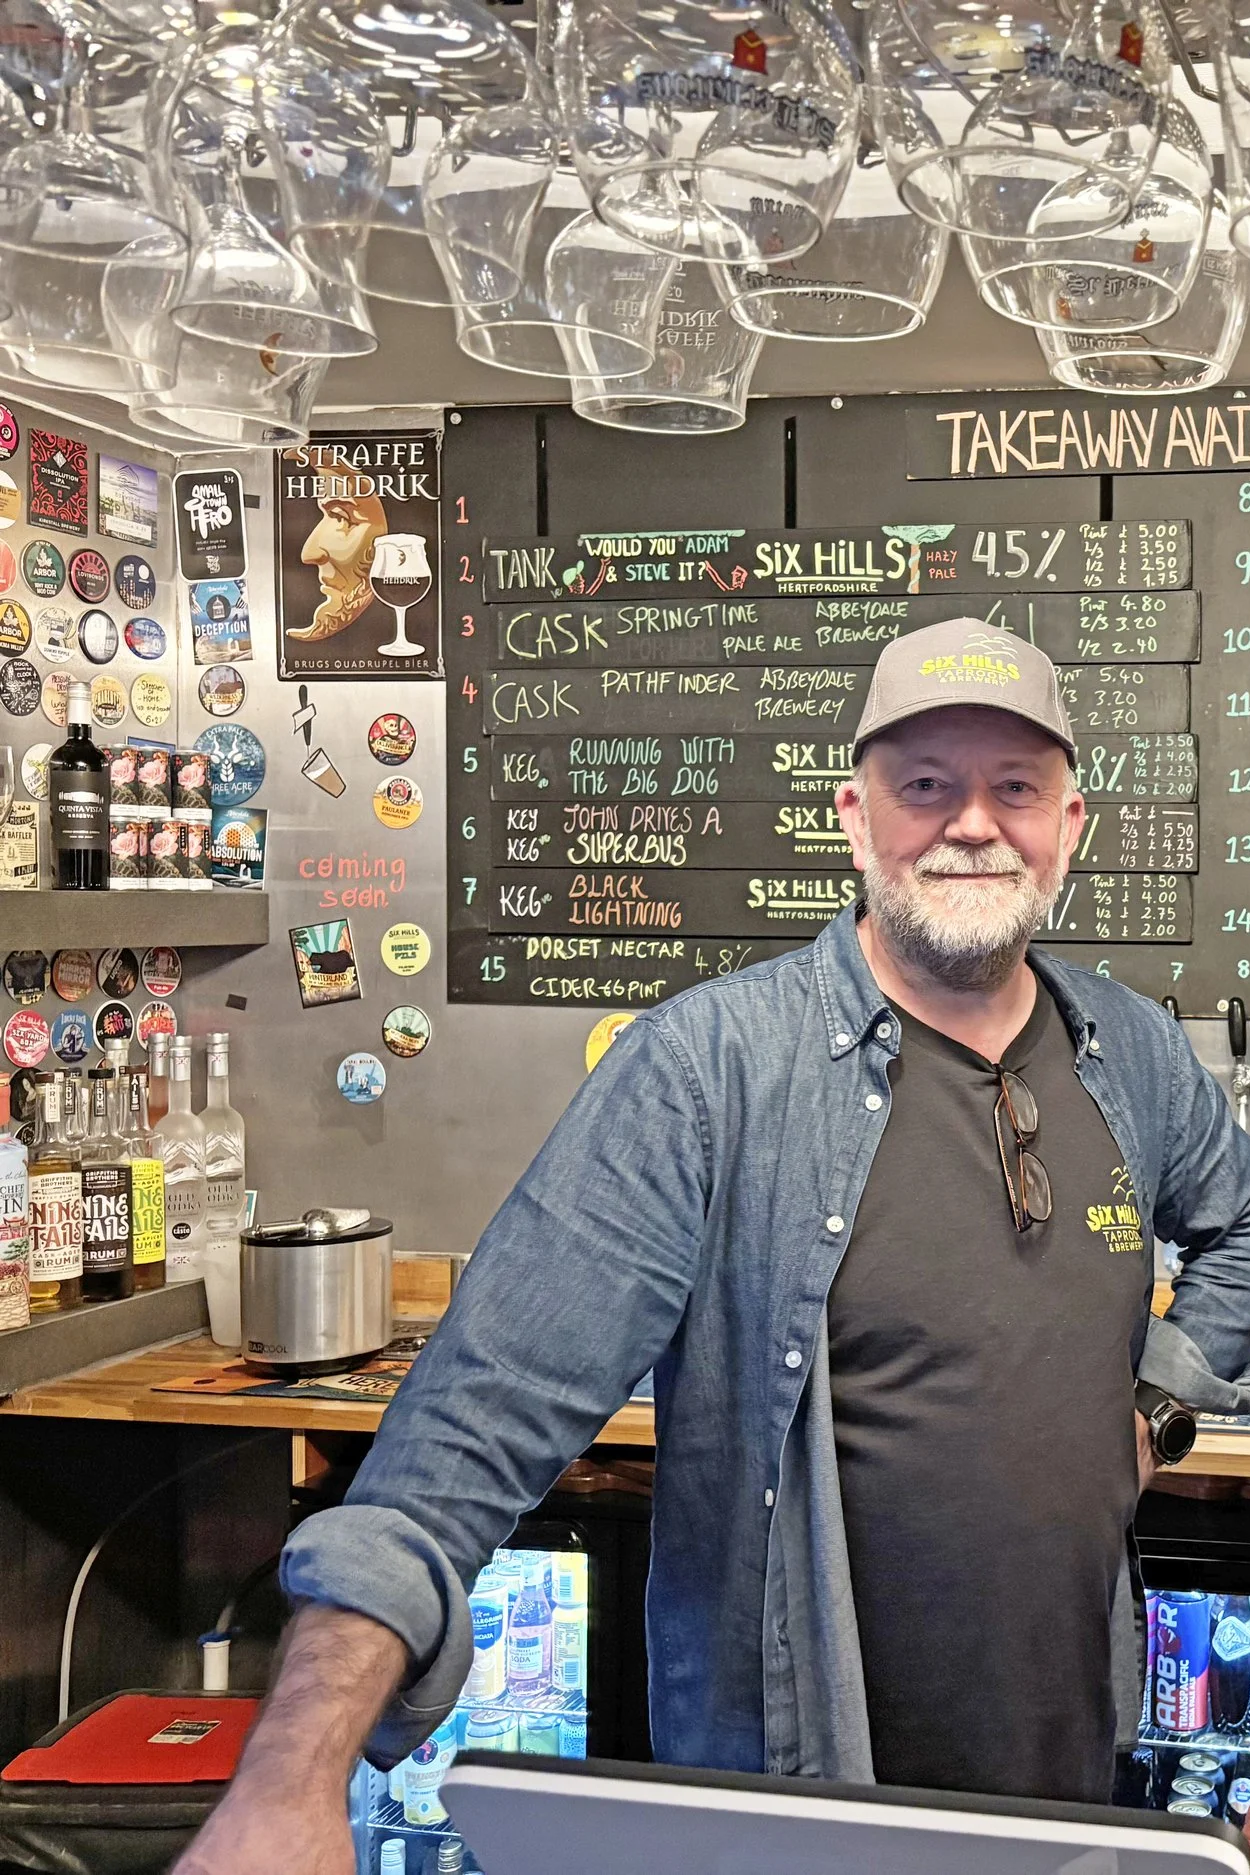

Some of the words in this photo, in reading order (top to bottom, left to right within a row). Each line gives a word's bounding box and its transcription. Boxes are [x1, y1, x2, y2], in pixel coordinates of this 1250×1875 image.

[936, 407, 1159, 474] TAKEAWAY
[295, 442, 426, 471] STRAFFE
[41, 467, 80, 483] DISSOLUTION
[286, 467, 440, 501] HENDRIK
[585, 538, 642, 558] WOULD
[649, 537, 676, 557] YOU
[685, 536, 729, 554] ADAM
[926, 550, 958, 563] HAZY
[459, 556, 474, 583] 2
[489, 548, 557, 590] TANK
[626, 563, 670, 581] STEVE
[928, 567, 957, 579] PALE
[778, 582, 879, 593] HERTFORDSHIRE
[815, 601, 908, 619] ABBEYDALE
[1120, 594, 1167, 612] 4.80
[195, 621, 248, 637] DECEPTION
[461, 615, 475, 637] 3
[616, 603, 759, 635] SPRINGTIME
[1115, 616, 1157, 631] 3.20
[506, 612, 608, 659] CASK
[723, 636, 765, 658] PALE
[773, 635, 803, 652] ALE
[815, 624, 901, 646] BREWERY
[1112, 636, 1158, 654] 2.40
[294, 660, 330, 670] BRUGS
[334, 659, 401, 669] QUADRUPEL
[936, 669, 1009, 683] TAPROOM
[462, 675, 478, 704] 4
[601, 671, 741, 698] PATHFINDER
[949, 675, 1008, 687] BREWERY
[493, 680, 579, 723] CASK
[463, 747, 478, 773] 5
[569, 737, 662, 766] RUNNING
[680, 737, 735, 765] WITH
[503, 753, 541, 784] KEG
[569, 769, 608, 795] THE
[622, 769, 658, 796] BIG
[671, 767, 719, 795] DOG
[58, 804, 84, 813] QUINTA
[507, 808, 539, 831] KEY
[564, 804, 619, 833] JOHN
[702, 807, 722, 835] A
[463, 816, 476, 840] 6
[507, 837, 540, 861] KEG
[567, 831, 687, 866] SUPERBUS
[299, 852, 406, 893] coming
[319, 884, 389, 909] soon
[464, 876, 477, 905] 7
[569, 875, 648, 899] BLACK
[499, 885, 543, 918] KEG
[569, 901, 682, 929] LIGHTNING
[391, 943, 419, 952] HOUSE
[526, 937, 601, 960] DORSET
[611, 939, 685, 958] NECTAR
[480, 956, 506, 982] 15
[46, 1256, 72, 1267] RUM
[1178, 1659, 1190, 1729] TRANSPACIFIC
